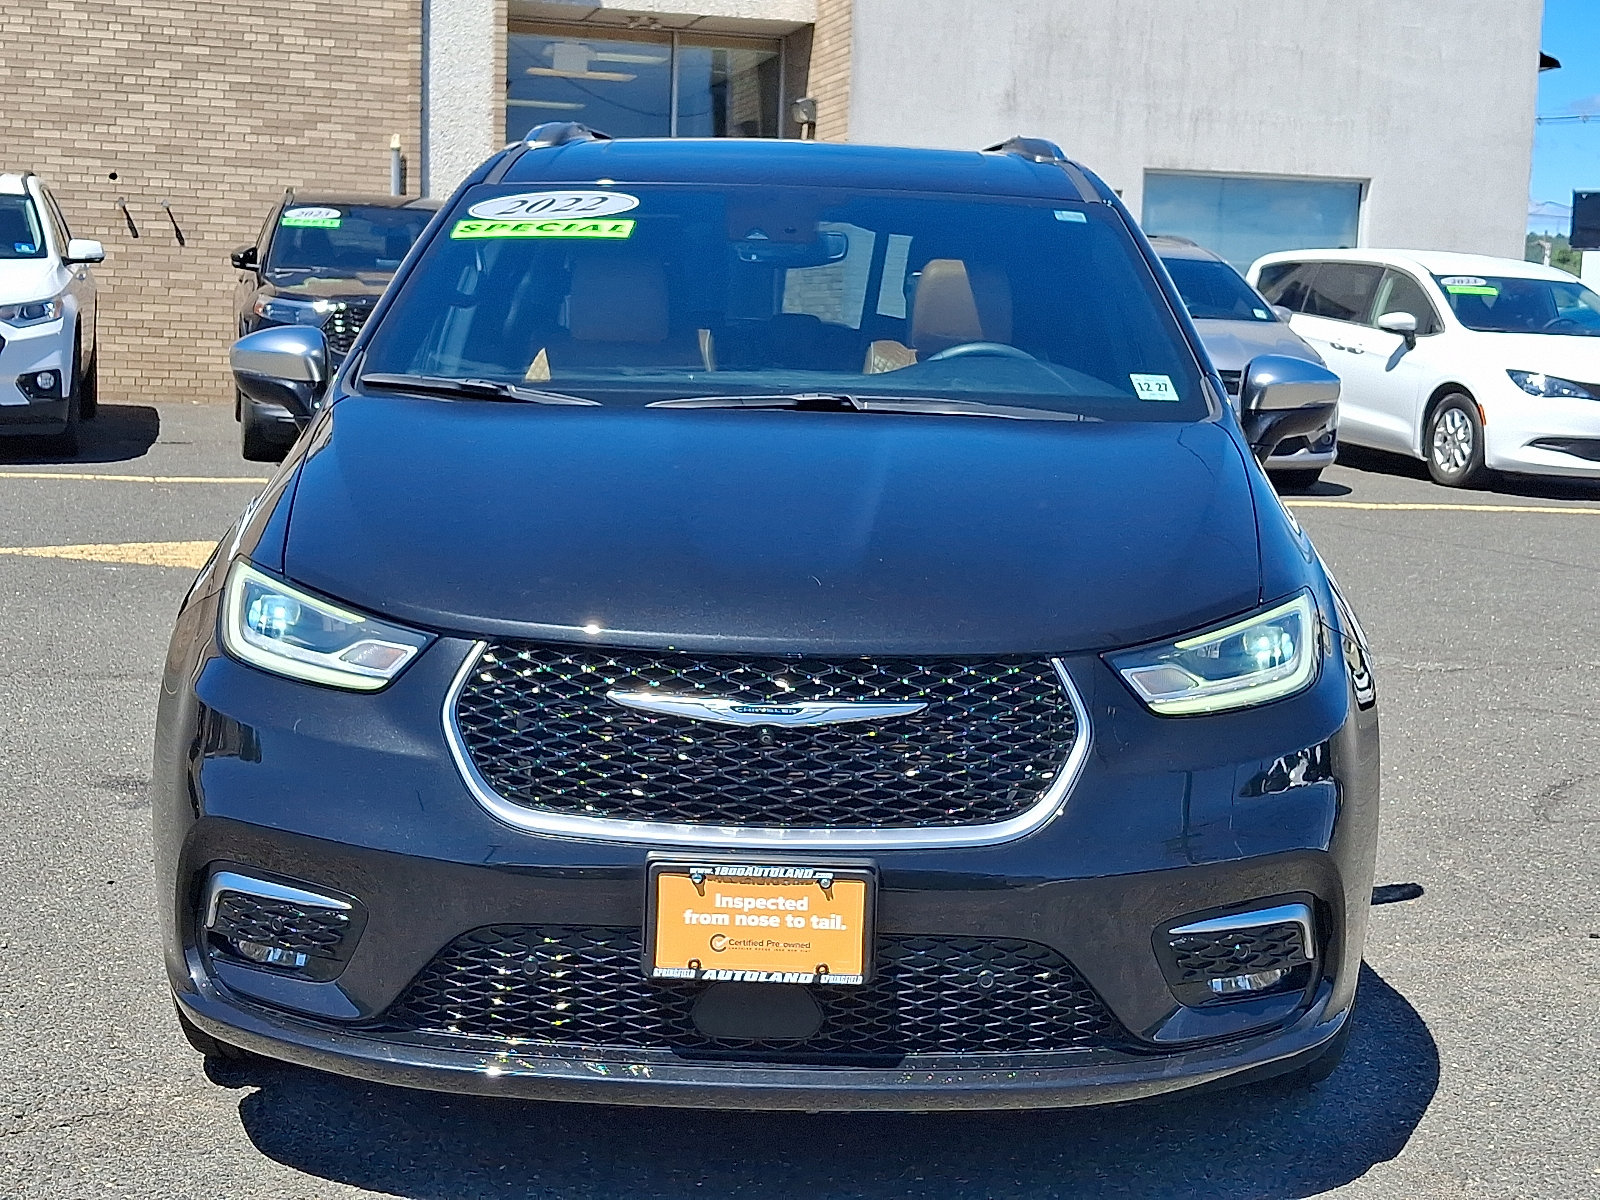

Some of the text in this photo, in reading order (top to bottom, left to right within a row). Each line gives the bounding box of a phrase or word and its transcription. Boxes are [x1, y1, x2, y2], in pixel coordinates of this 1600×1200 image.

[495, 196, 609, 216] 2022
[458, 222, 626, 233] SPECIAL
[1137, 382, 1168, 392] 12 27
[734, 706, 797, 714] CHRYSLER
[715, 893, 809, 912] Inspected
[683, 908, 847, 931] from nose to tail.
[728, 938, 764, 947] Certified
[701, 969, 814, 984] AUTOLAND
